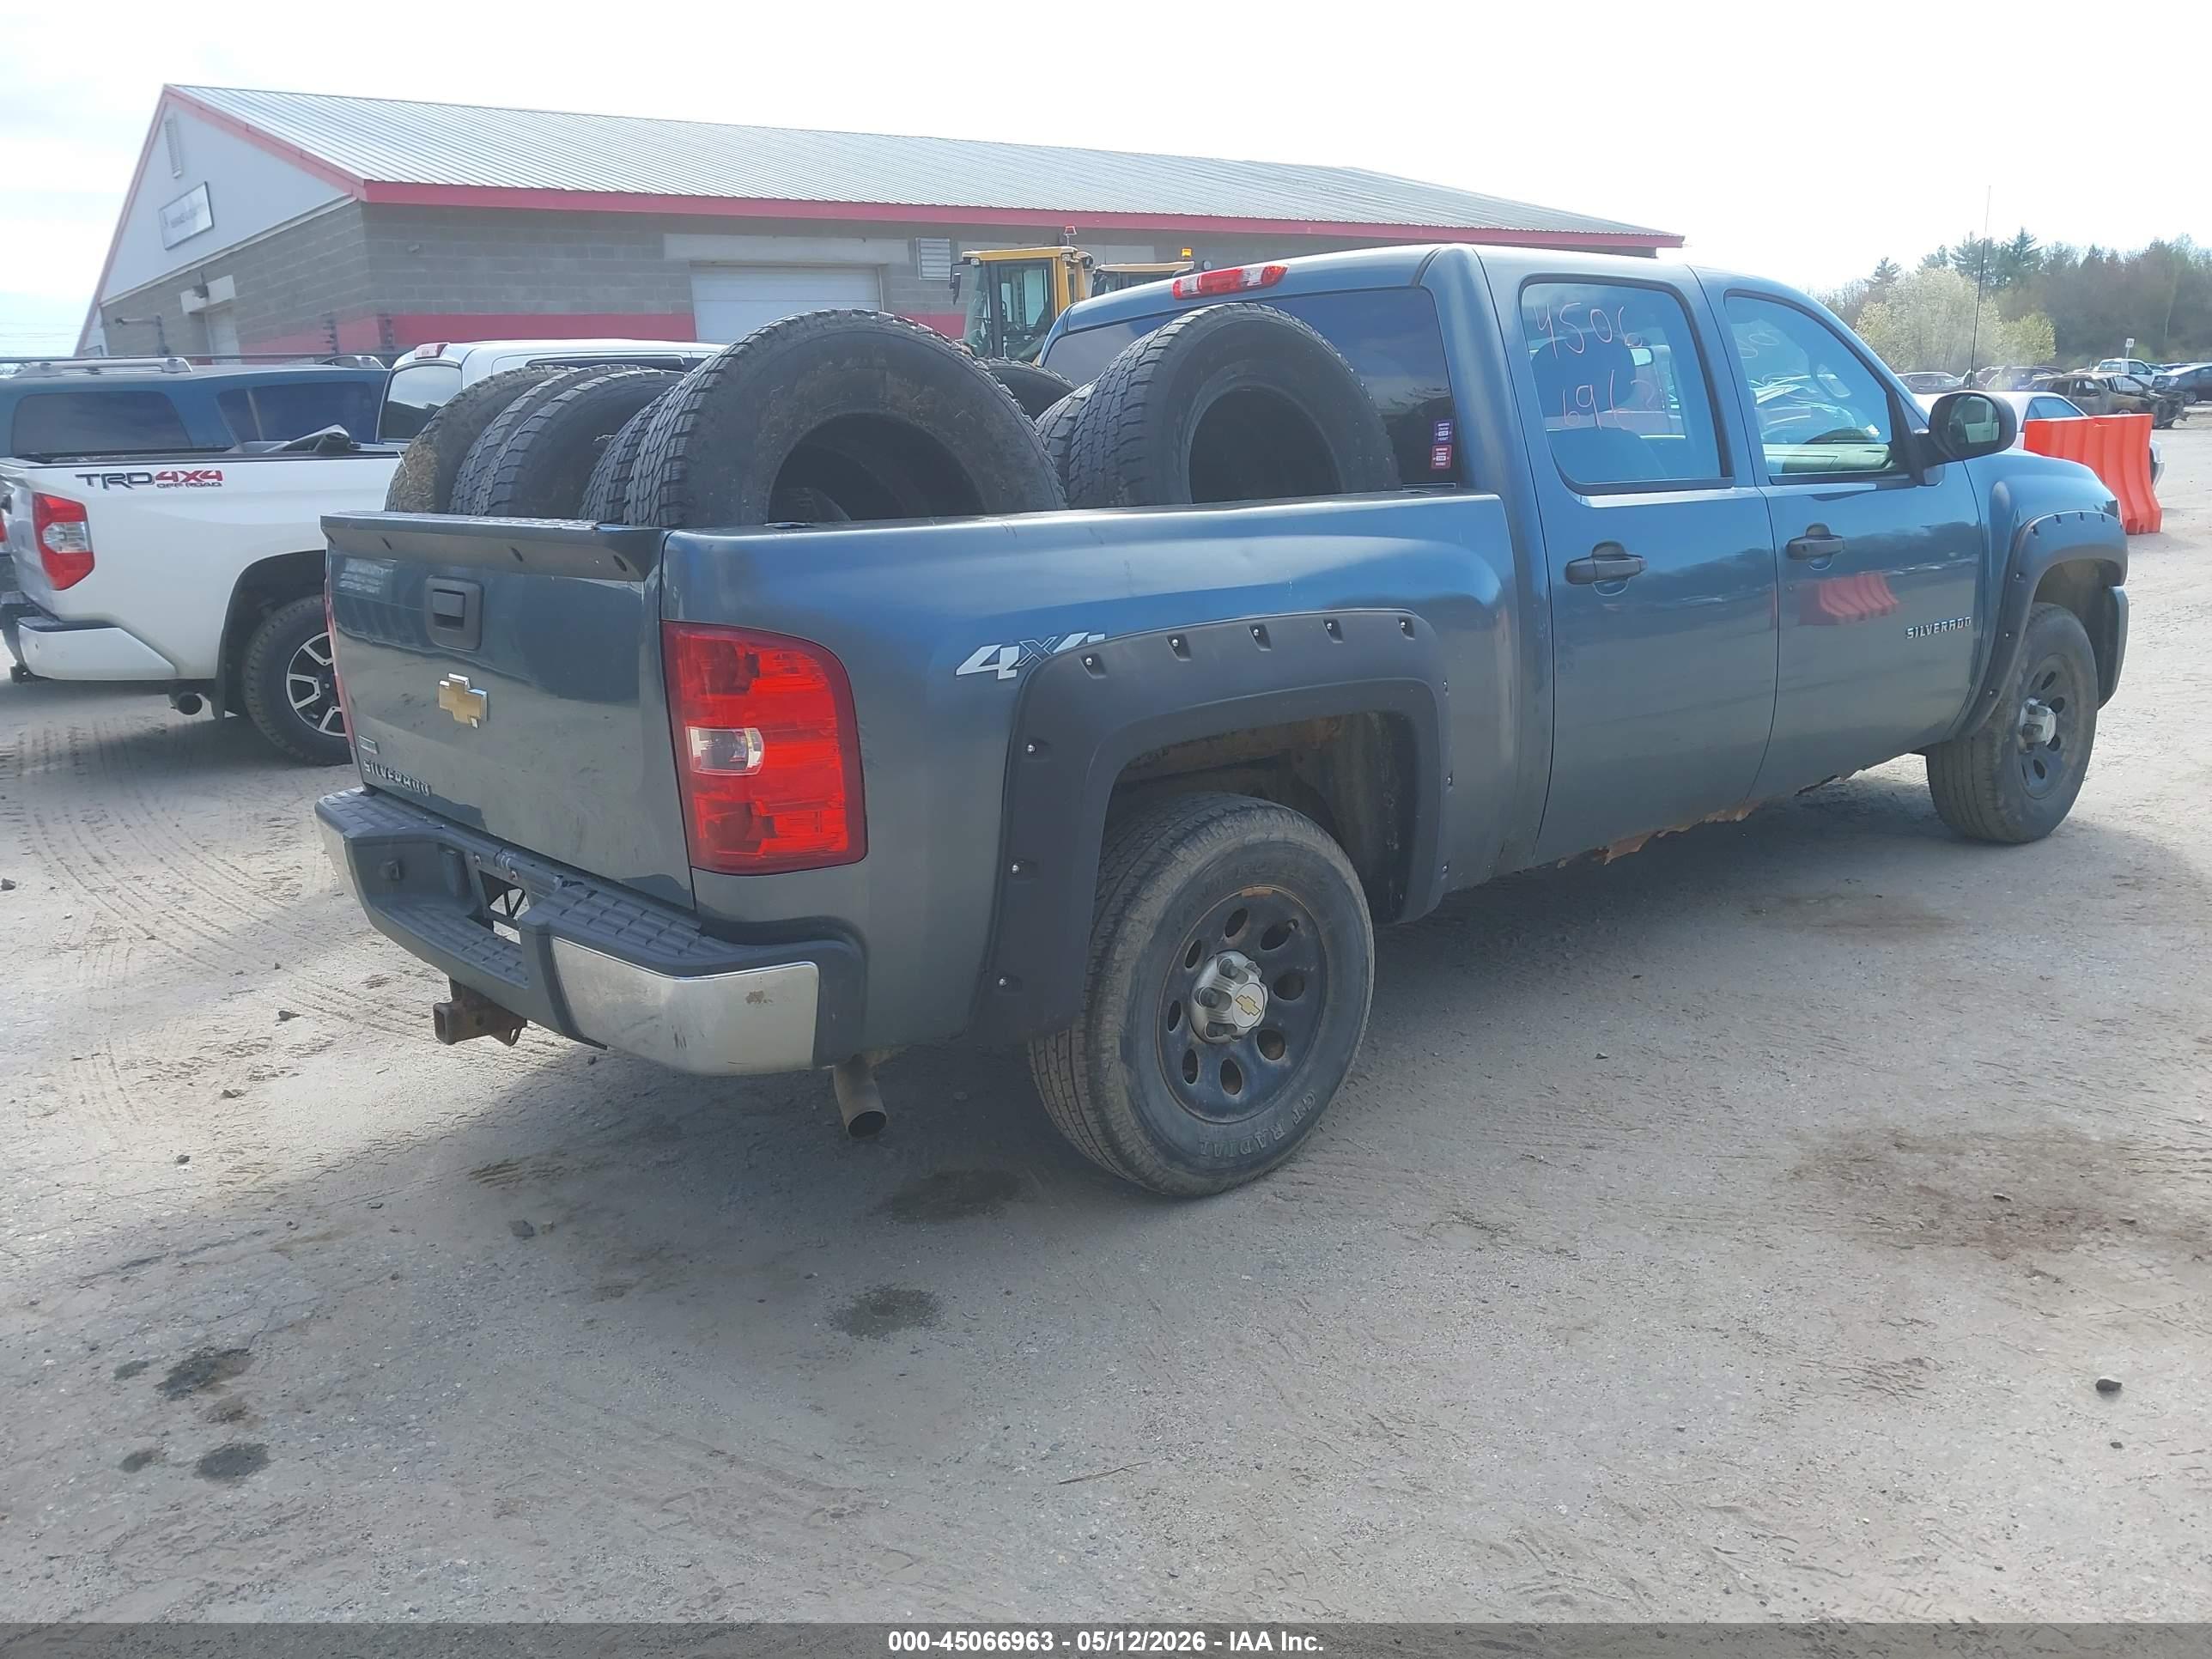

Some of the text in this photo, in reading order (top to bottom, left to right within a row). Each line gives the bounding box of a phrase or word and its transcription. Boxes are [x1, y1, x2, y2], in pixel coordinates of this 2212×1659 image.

[1533, 301, 1643, 359] 4506
[75, 471, 155, 490] TRD
[1905, 616, 1972, 639] SILVERADO
[362, 757, 432, 797] SILVERADO
[1198, 1118, 1286, 1158] RADIAL
